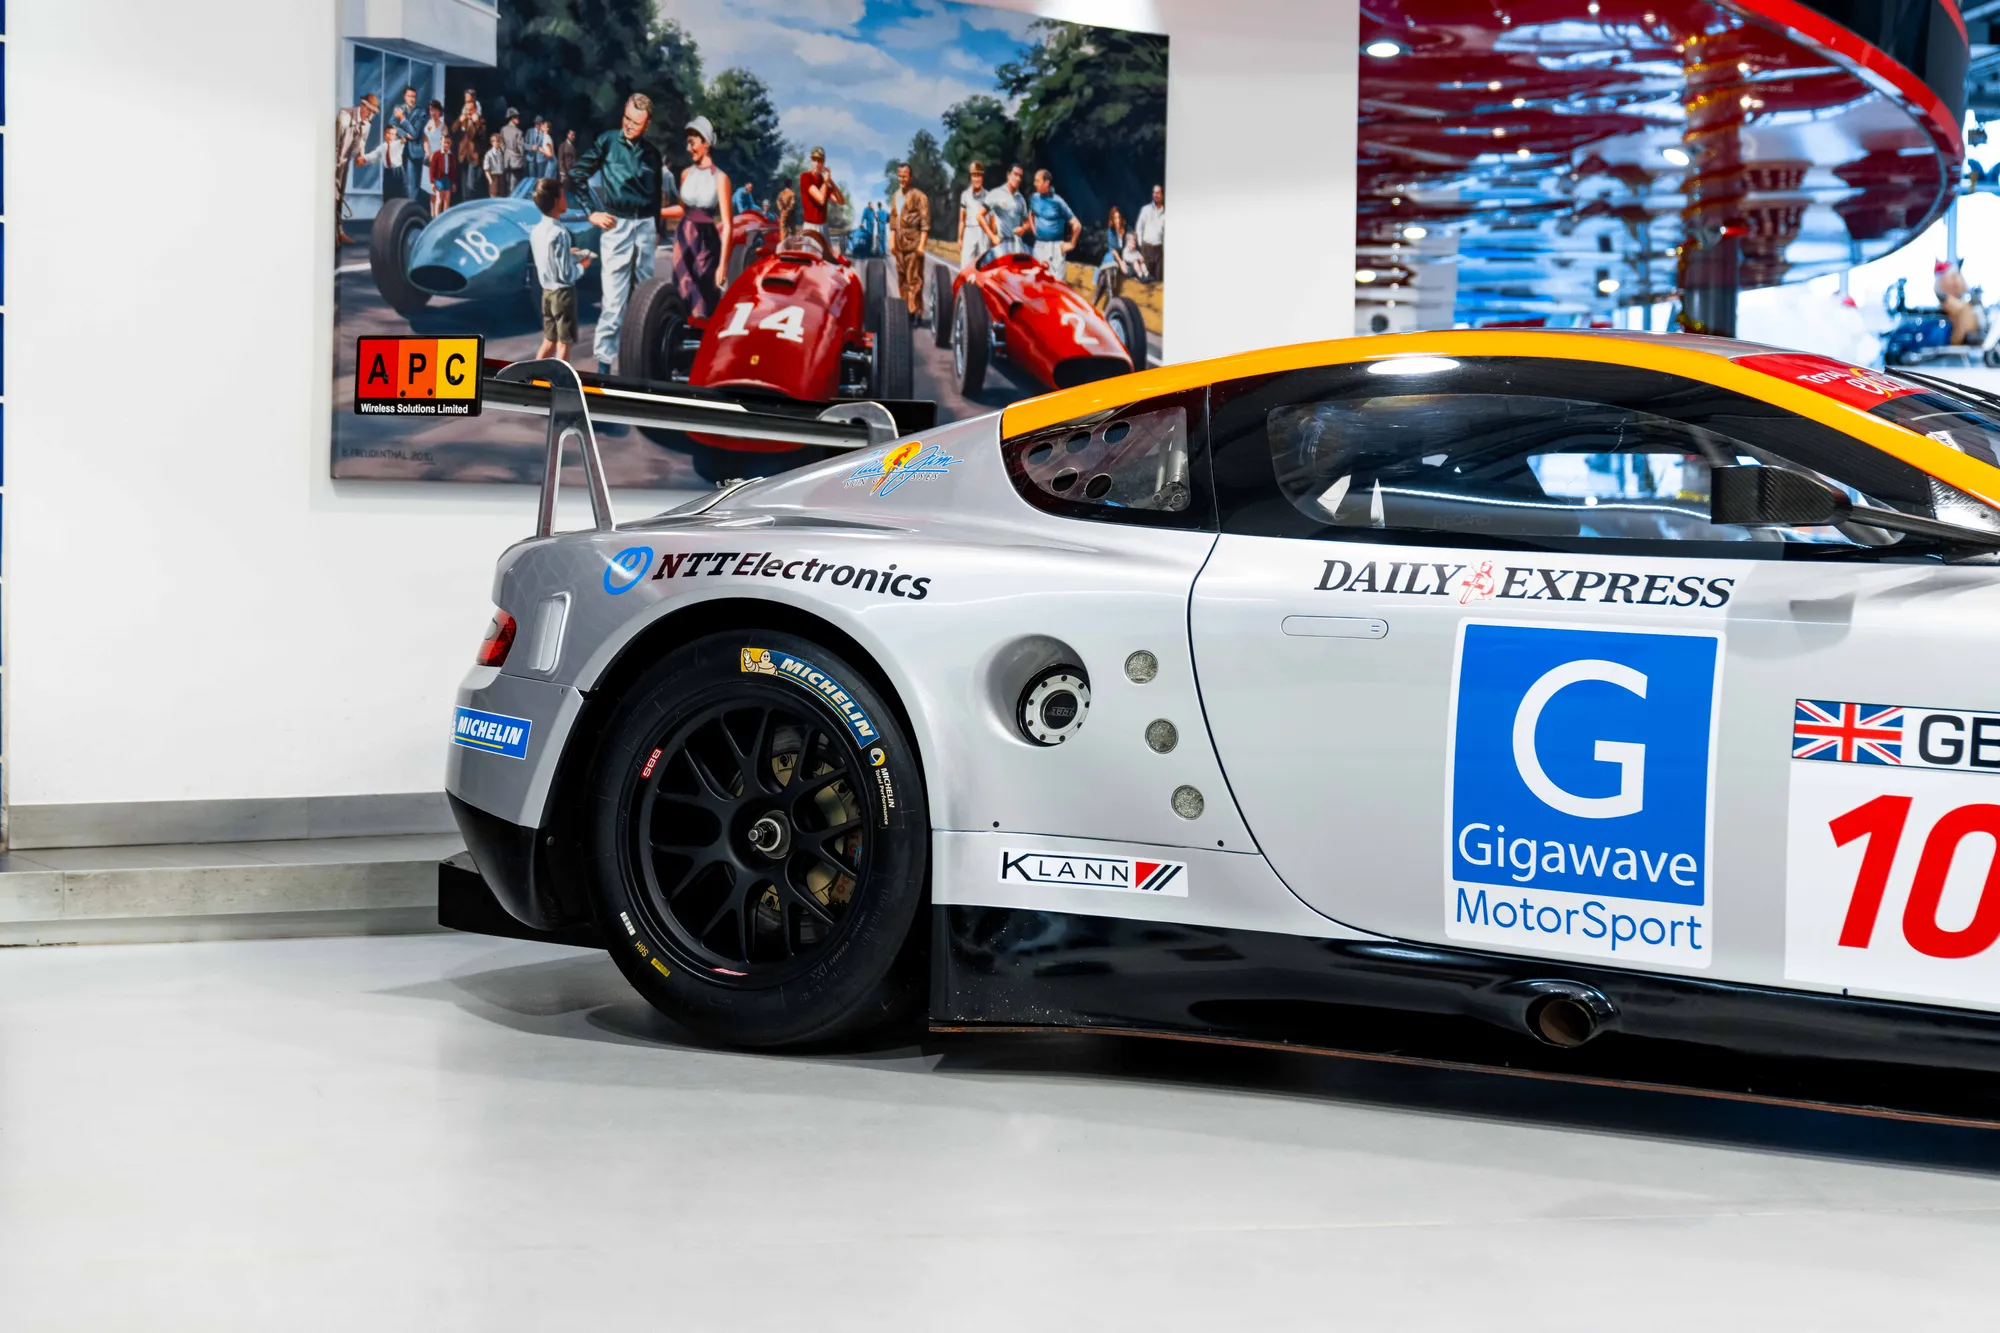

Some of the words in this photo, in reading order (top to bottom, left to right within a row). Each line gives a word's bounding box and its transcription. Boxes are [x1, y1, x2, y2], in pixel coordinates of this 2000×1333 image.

[454, 230, 500, 265] 18
[718, 301, 804, 343] 14
[1061, 313, 1099, 345] 2
[361, 403, 395, 413] Wireless
[397, 403, 435, 414] Solutions
[437, 404, 468, 414] Limited
[1314, 559, 1464, 596] DAILY
[1496, 566, 1735, 608] EXPRESS
[780, 658, 873, 737] MICHELIN
[457, 716, 523, 745] MICHELIN
[1512, 659, 1648, 818] G
[643, 749, 661, 777] BBS
[875, 769, 883, 784] Total
[879, 785, 889, 825] Performance
[881, 767, 895, 808] MICHELIN
[1002, 851, 1128, 882] KLANN
[1458, 822, 1698, 886] Gigawave
[1828, 794, 2000, 959] 10
[1456, 887, 1702, 951] MotorSport
